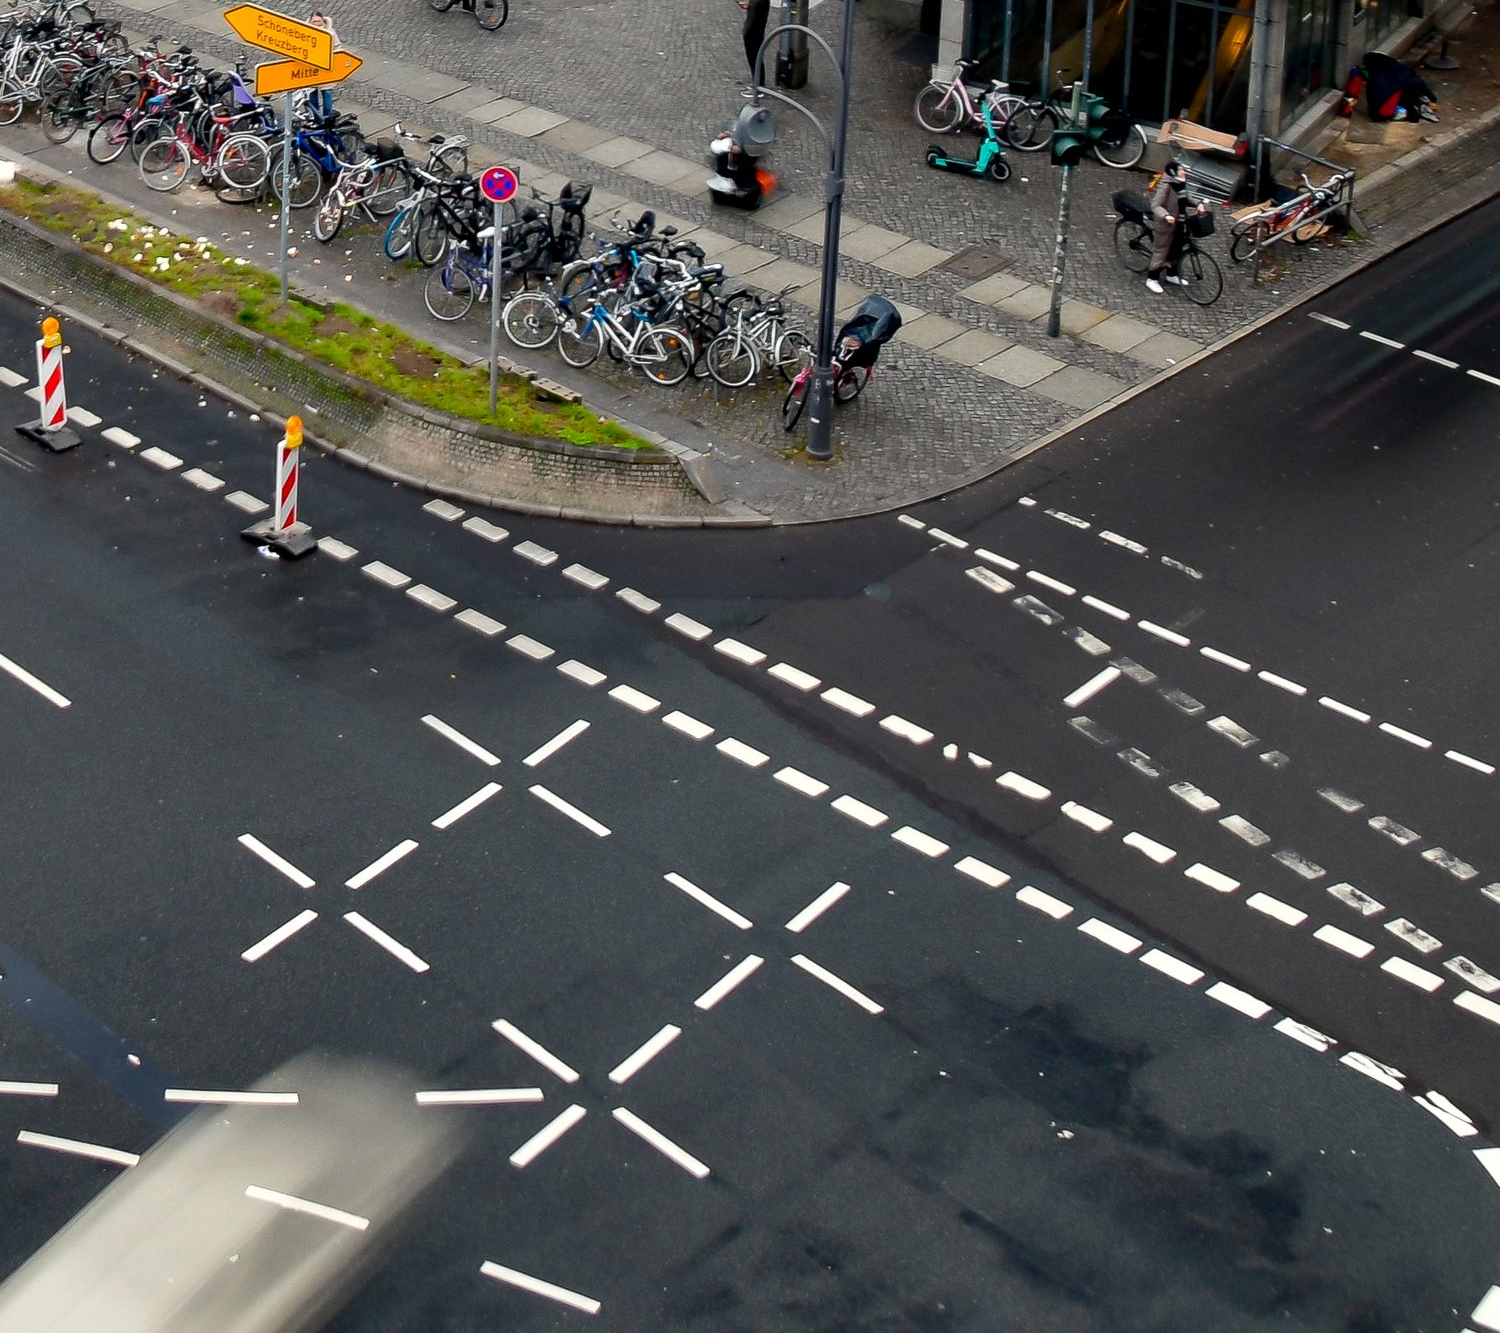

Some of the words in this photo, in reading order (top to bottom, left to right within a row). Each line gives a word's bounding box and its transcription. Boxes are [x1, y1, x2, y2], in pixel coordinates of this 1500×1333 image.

[256, 30, 309, 60] Kreuzberg
[257, 15, 318, 49] Schöneberg
[290, 66, 320, 81] Mitte
